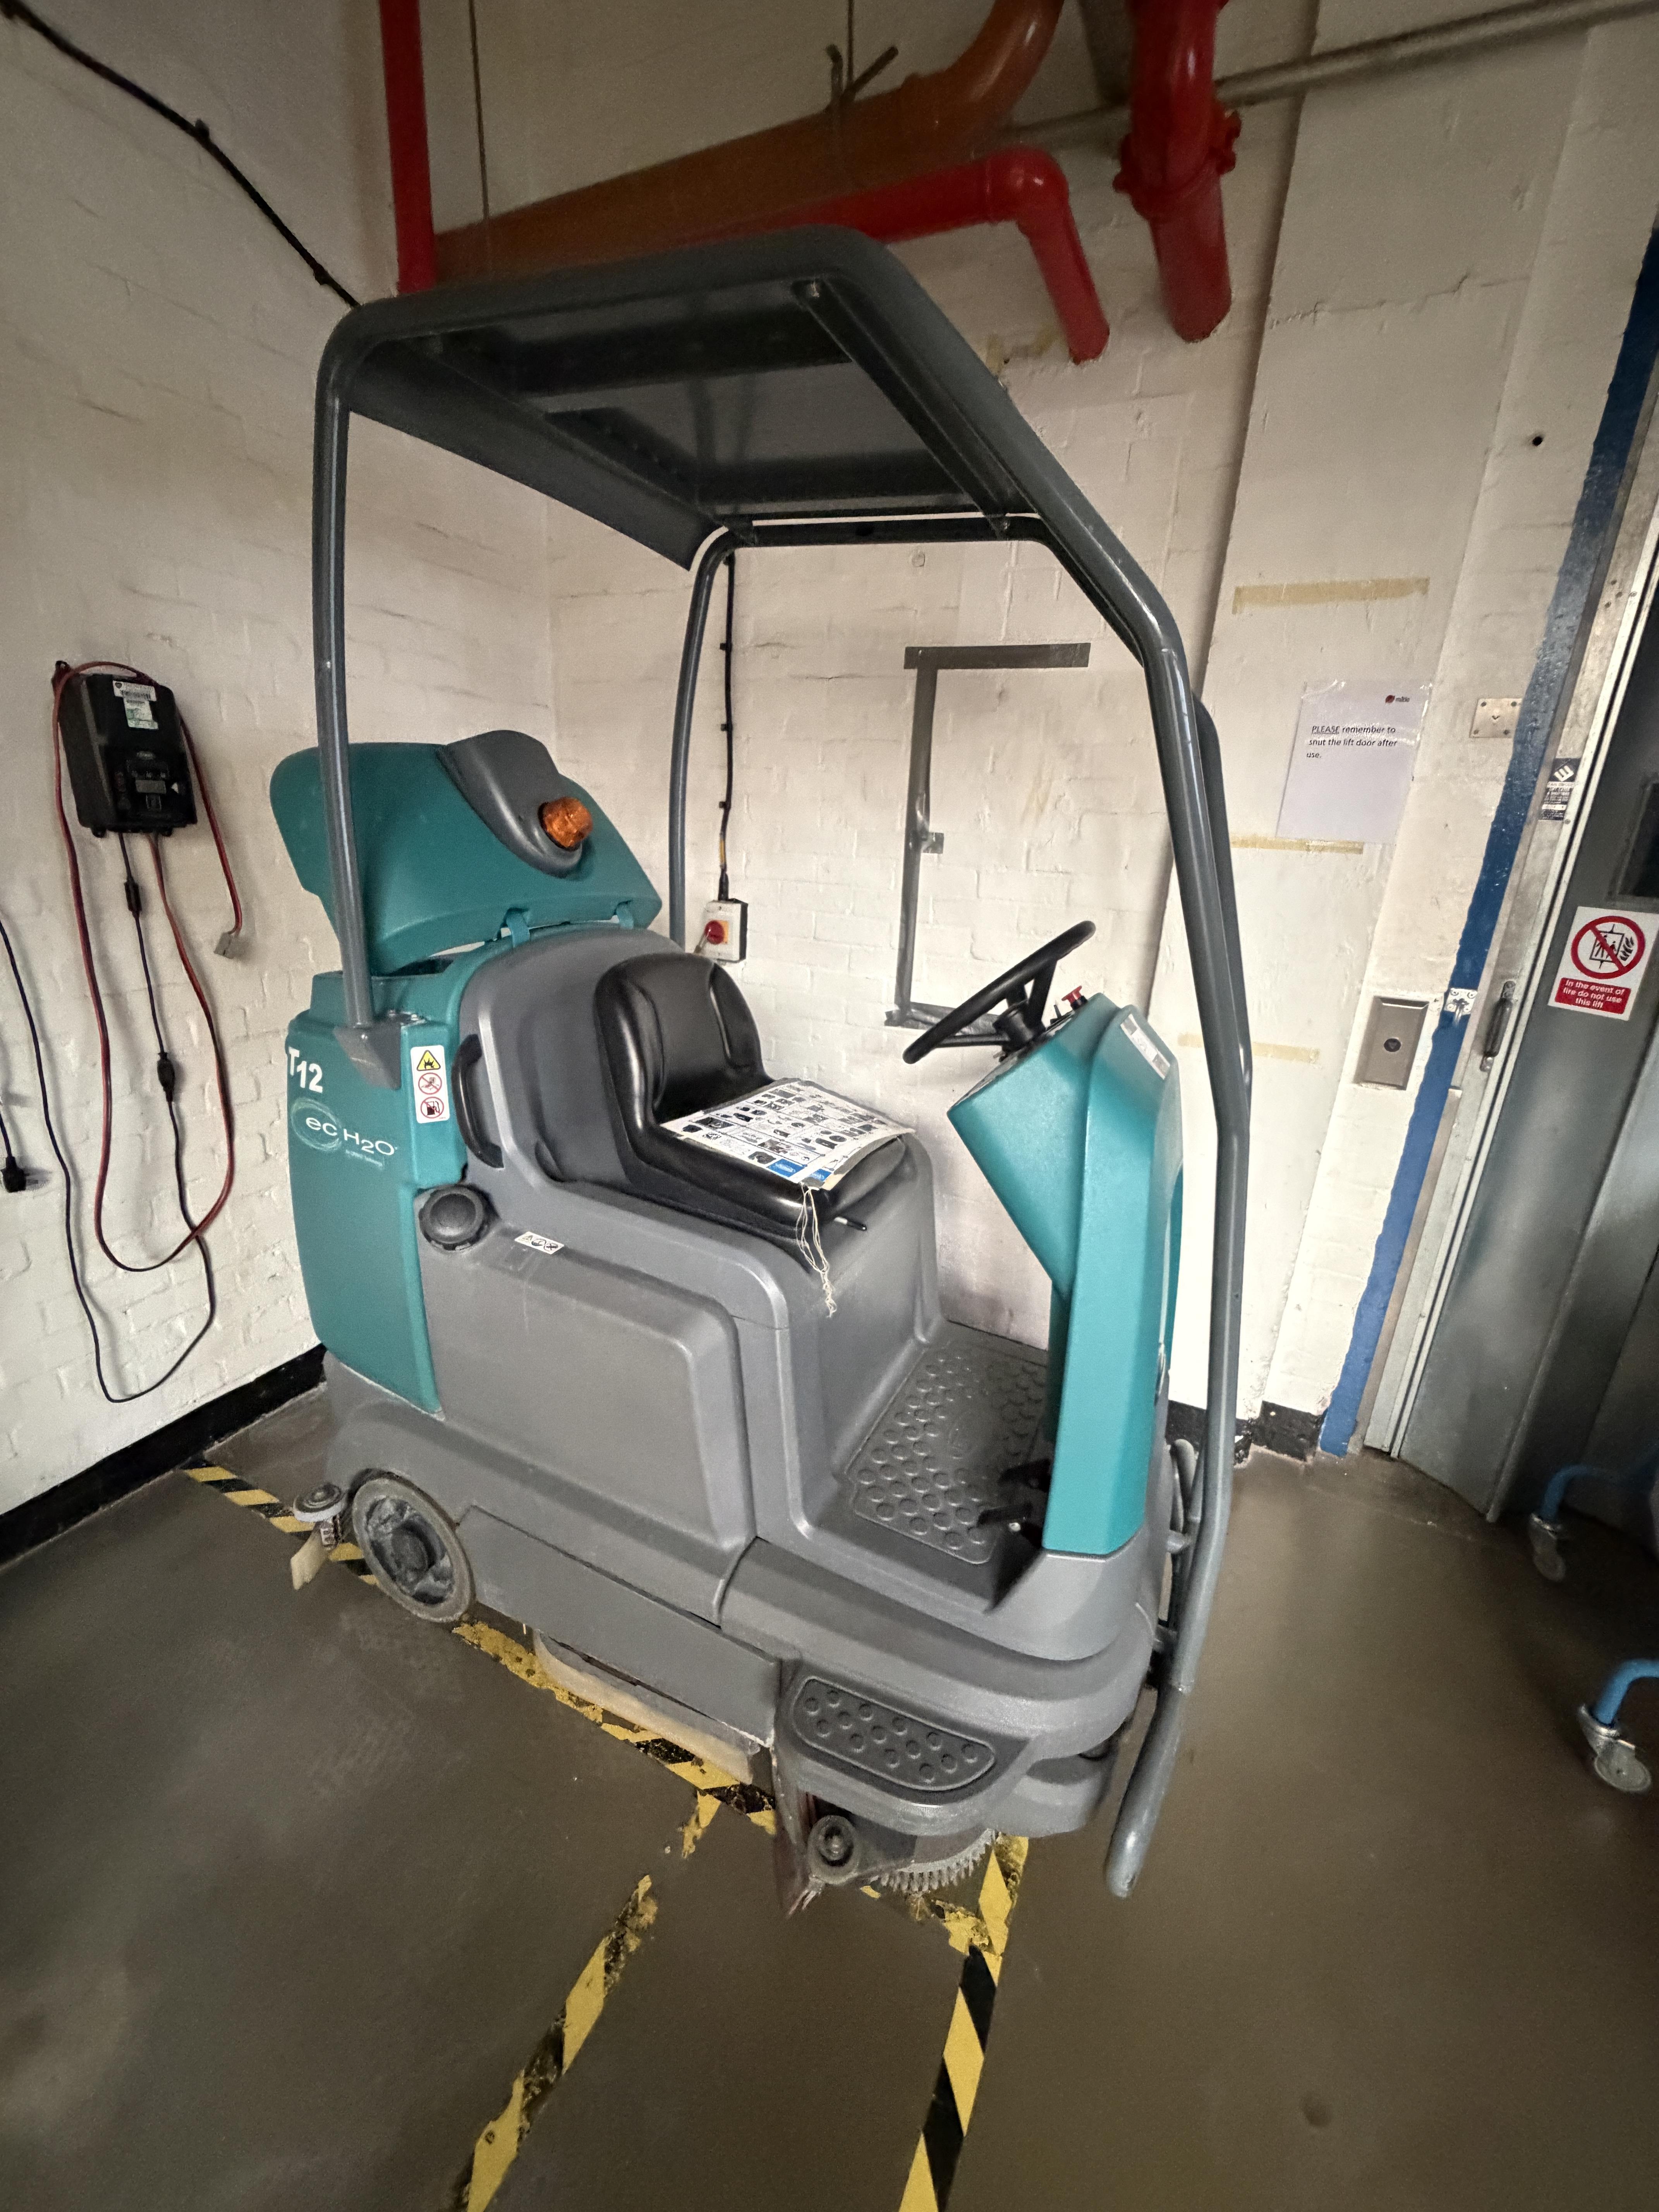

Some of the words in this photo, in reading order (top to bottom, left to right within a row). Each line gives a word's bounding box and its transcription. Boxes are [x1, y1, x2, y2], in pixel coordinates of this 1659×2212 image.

[1312, 725, 1340, 734] PLEASE
[1563, 987, 1577, 995] fire
[1590, 985, 1614, 994] event
[1575, 997, 1591, 1006] this
[1592, 1000, 1604, 1009] lift
[288, 1046, 323, 1094] T12
